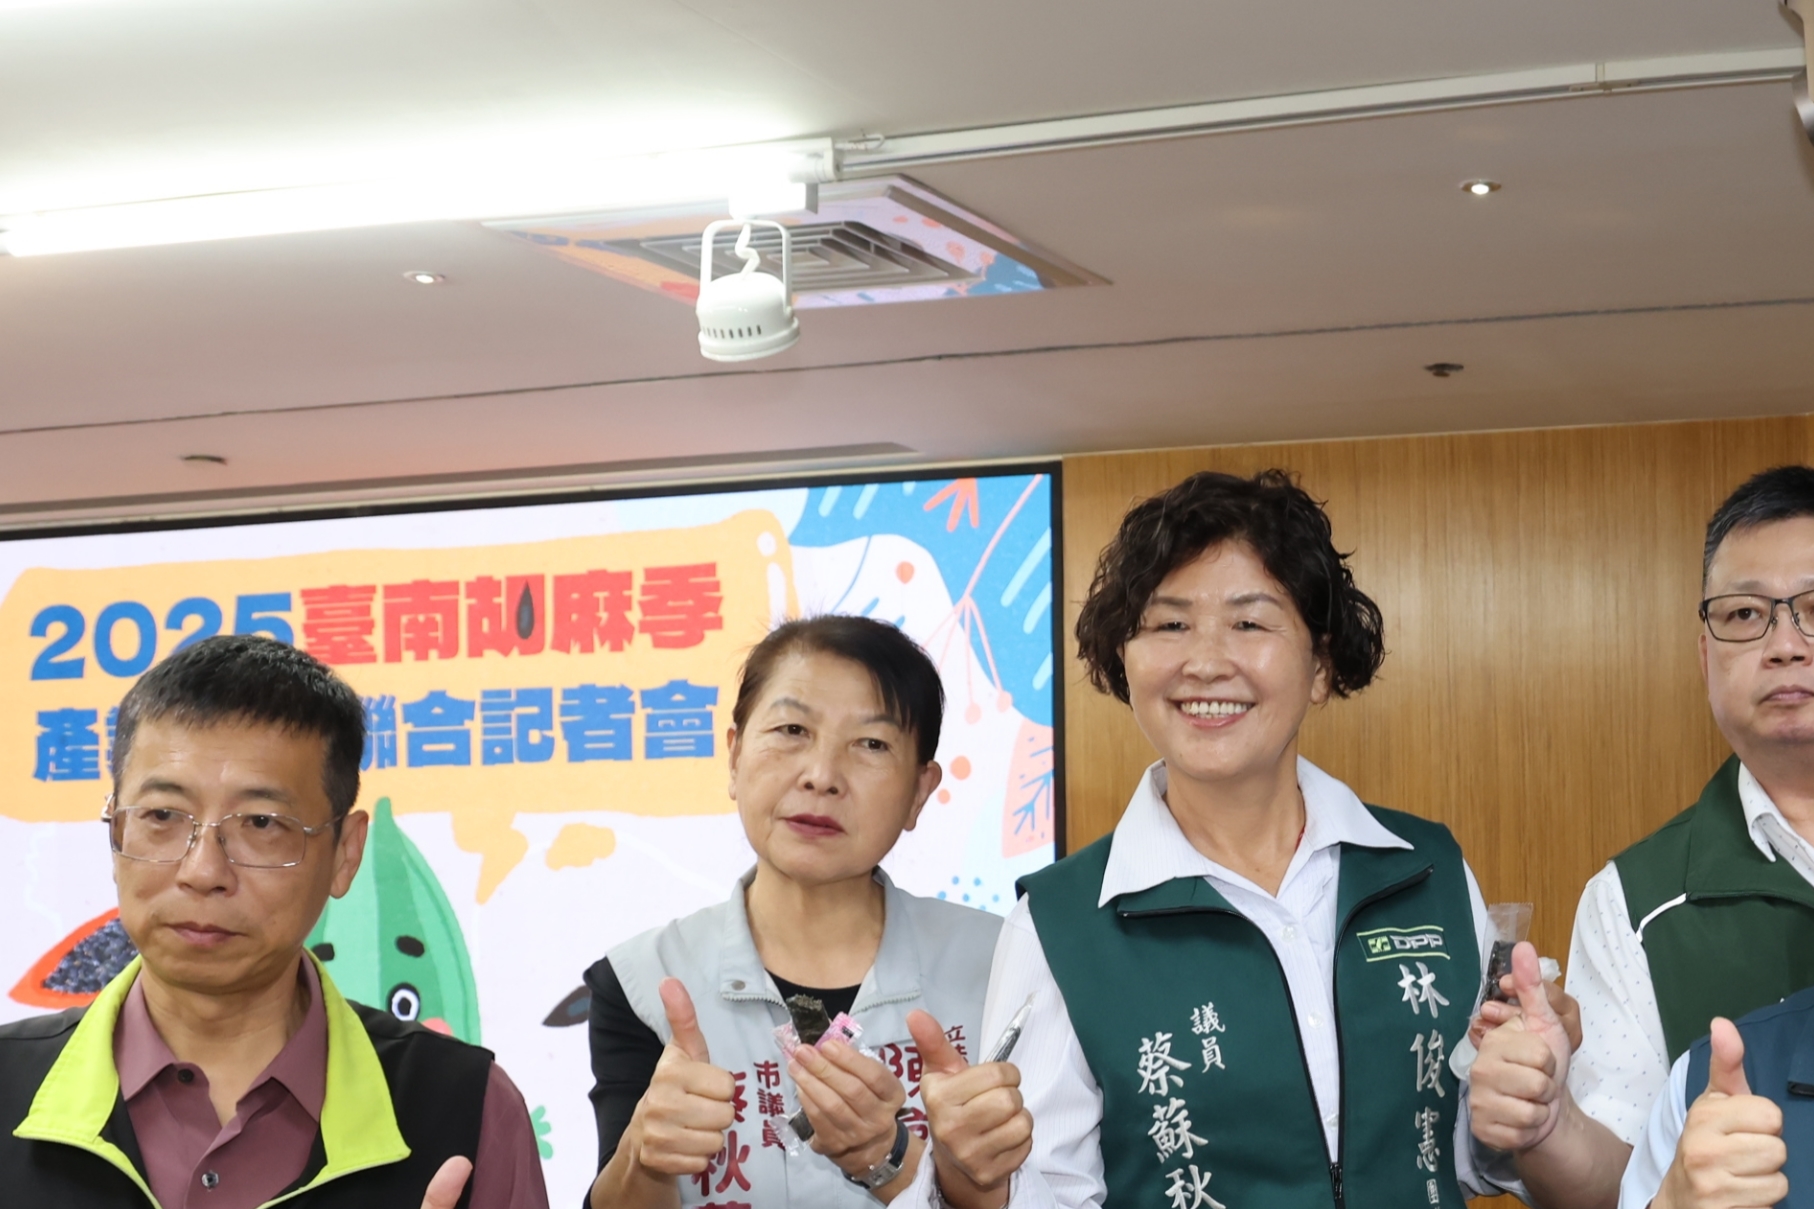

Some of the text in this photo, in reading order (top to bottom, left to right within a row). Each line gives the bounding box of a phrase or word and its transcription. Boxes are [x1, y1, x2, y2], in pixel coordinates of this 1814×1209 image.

[29, 561, 725, 681] 2025臺南胡麻季
[1389, 934, 1443, 951] DPP
[1190, 1001, 1226, 1074] 議員
[1397, 961, 1450, 1172] 林俊憲
[753, 1060, 788, 1151] 市議員
